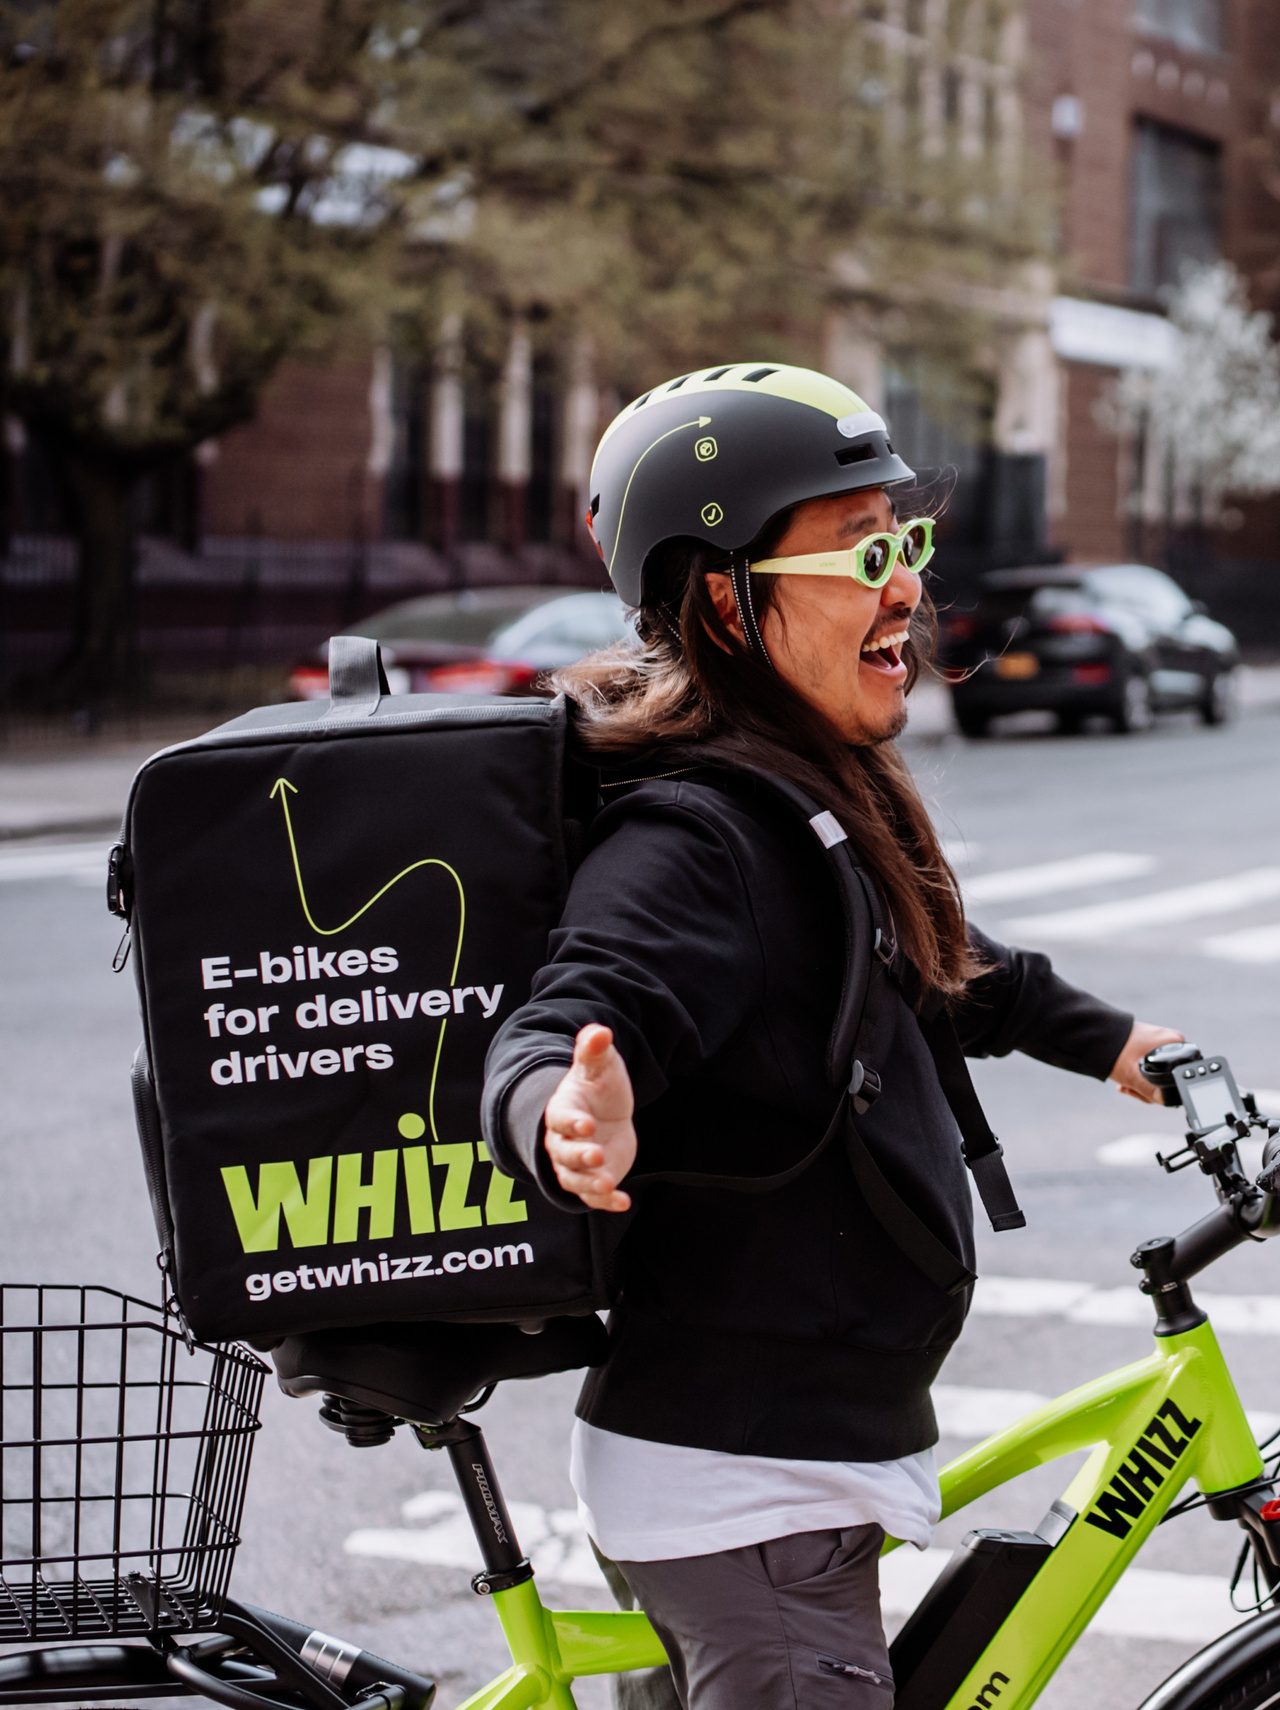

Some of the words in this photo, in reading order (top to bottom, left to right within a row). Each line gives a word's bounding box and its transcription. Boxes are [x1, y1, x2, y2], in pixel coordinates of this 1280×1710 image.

[201, 945, 399, 990] E-bikes
[203, 1003, 280, 1037] for
[295, 984, 504, 1029] delivery
[210, 1043, 395, 1086] drivers
[245, 1242, 534, 1301] getwhizz.com
[1084, 1397, 1203, 1540] WHIZZ
[471, 1463, 509, 1544] PROMAX
